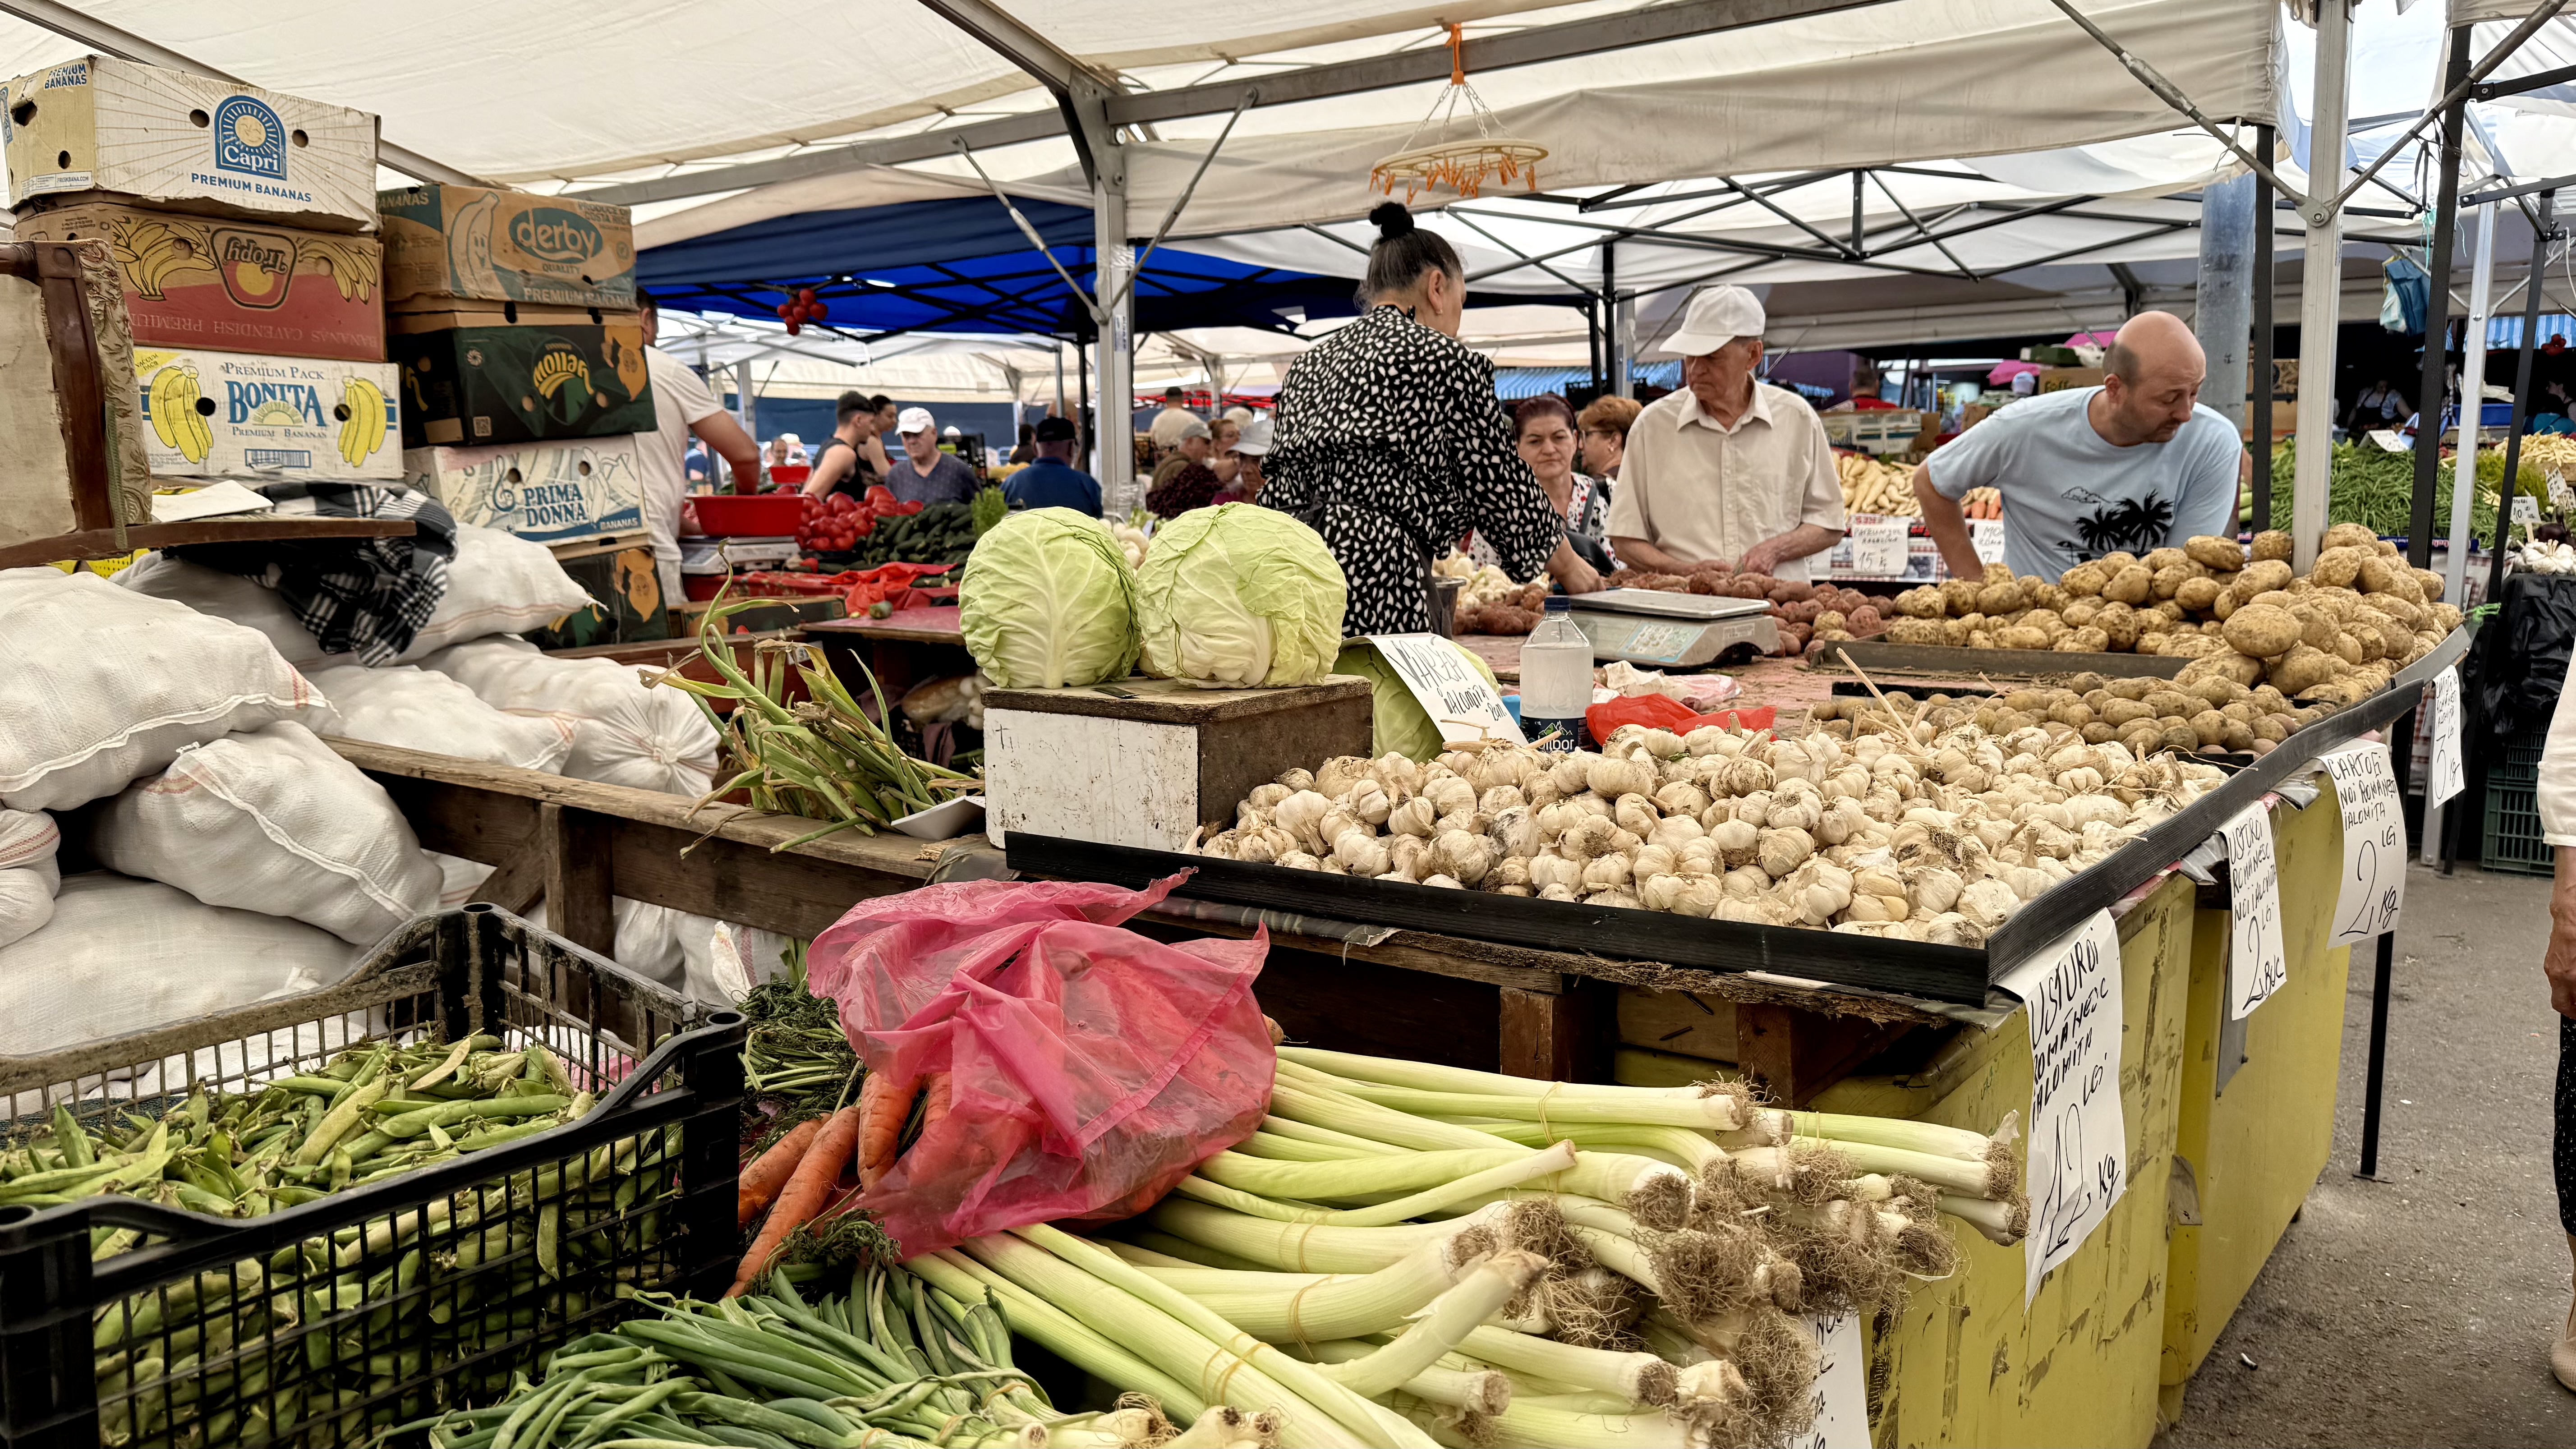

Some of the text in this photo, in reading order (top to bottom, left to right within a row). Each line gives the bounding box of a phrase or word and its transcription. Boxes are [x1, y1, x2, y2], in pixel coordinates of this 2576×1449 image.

[44, 74, 87, 89] BANANAS
[48, 64, 86, 78] PREMIUM
[224, 145, 278, 171] Capri
[191, 173, 311, 202] PREMIUM BANANAS
[517, 209, 595, 261] derby
[222, 236, 288, 274] Tropy
[543, 263, 580, 274] QUALITY
[524, 288, 583, 304] PREMIUM
[214, 321, 303, 340] CAVENDISH
[224, 380, 327, 427] BONITA
[522, 483, 584, 506] PRIMA
[525, 502, 588, 527] DONNA
[600, 518, 638, 530] BANANAS
[2435, 734, 2446, 800] 3
